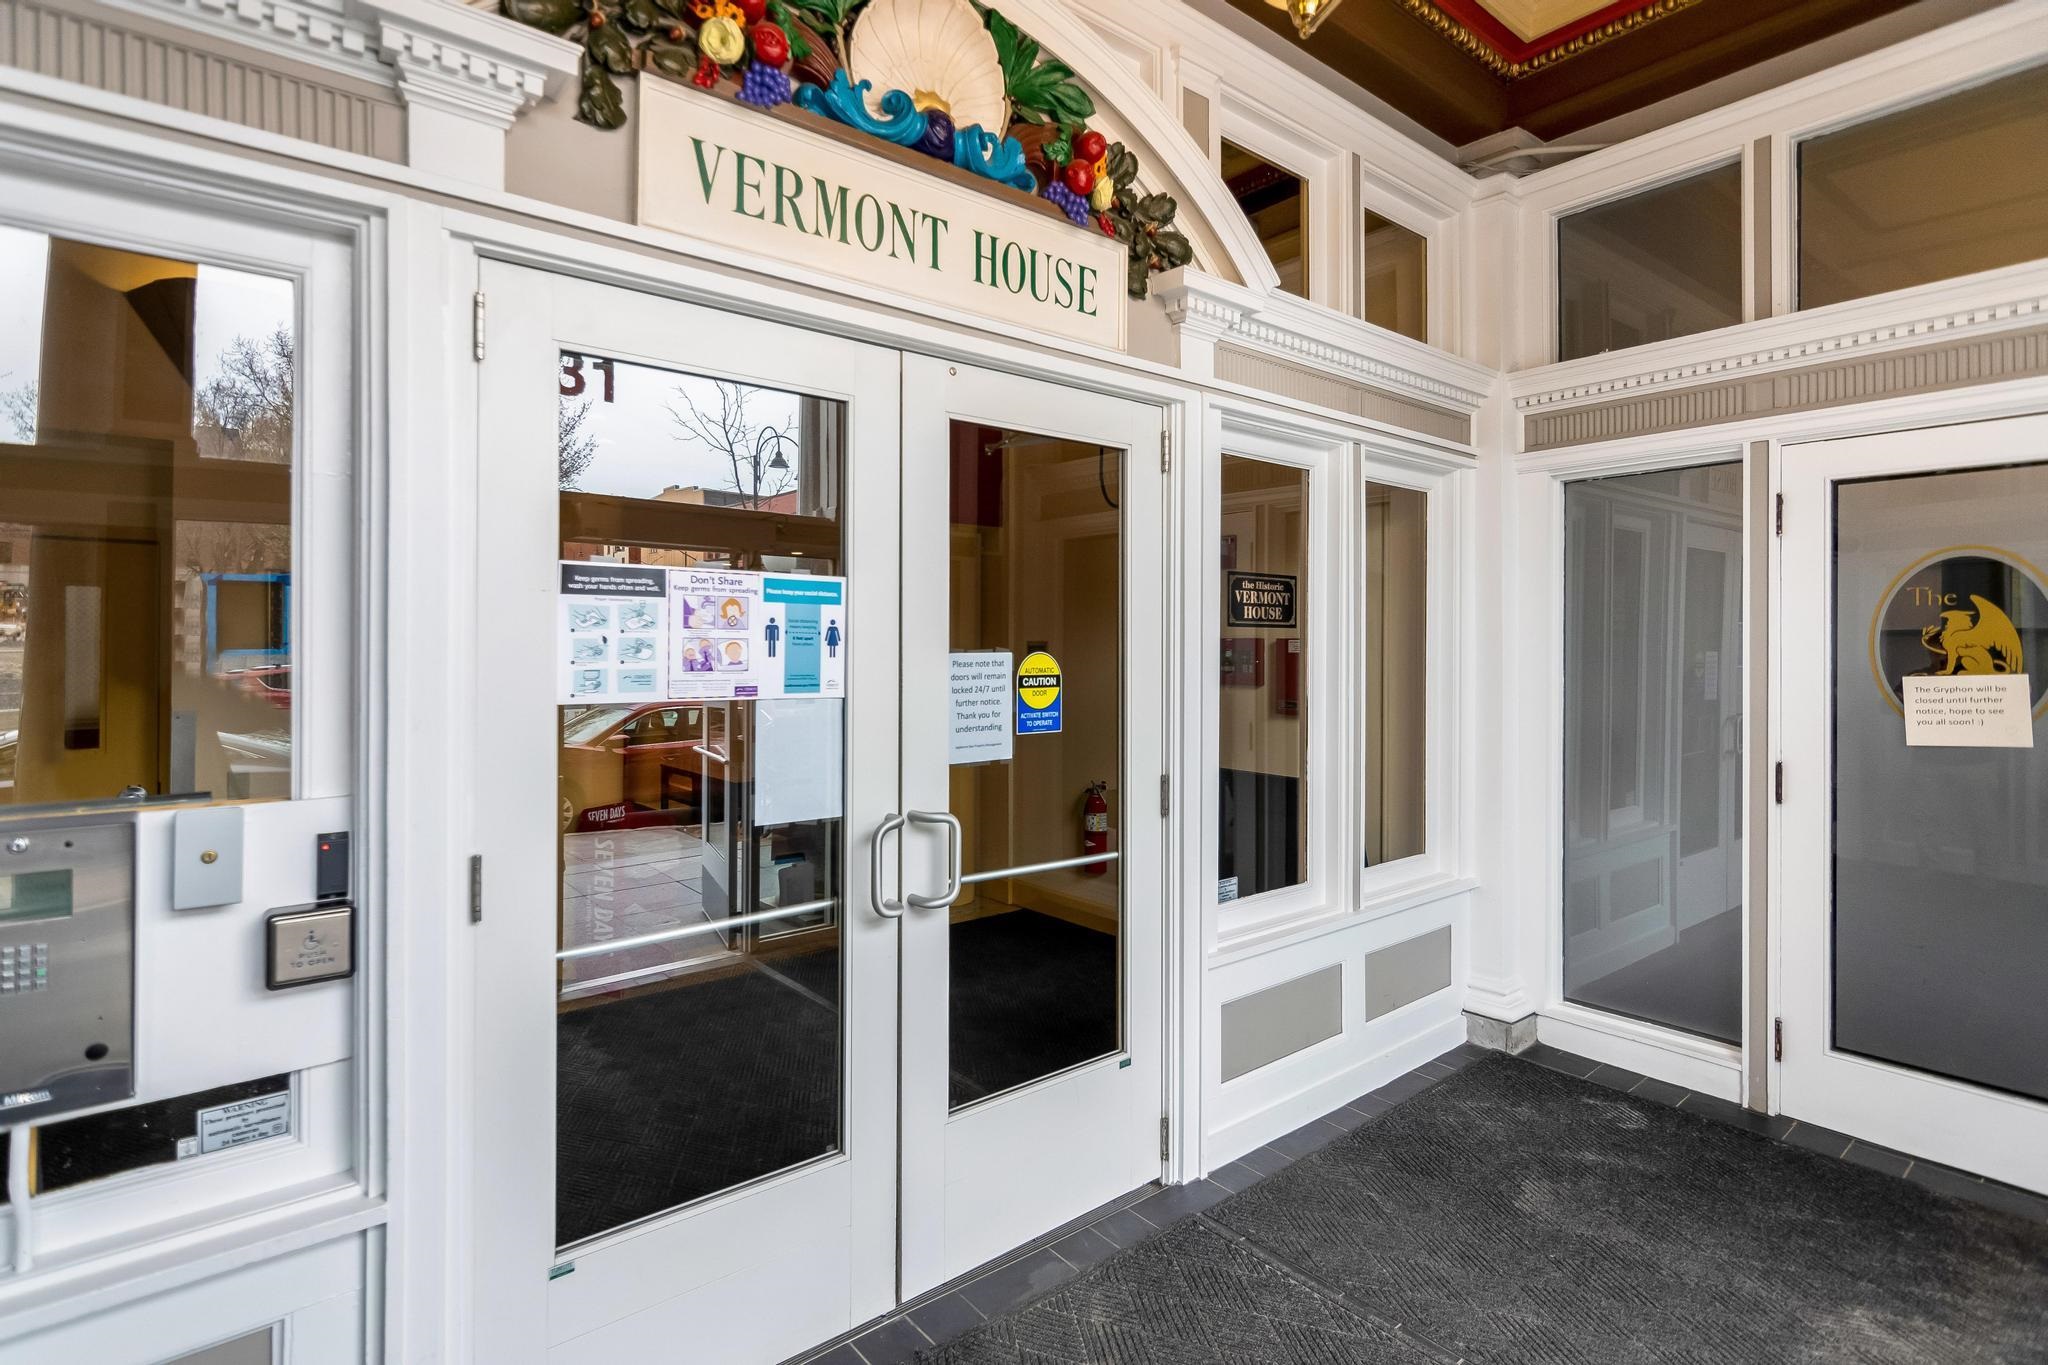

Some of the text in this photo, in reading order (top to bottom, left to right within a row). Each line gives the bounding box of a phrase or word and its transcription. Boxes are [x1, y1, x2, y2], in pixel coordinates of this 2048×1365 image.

[688, 136, 1097, 316] VERMONT HOUSE
[574, 575, 590, 583] Keep
[690, 575, 743, 586] Don't Share
[1242, 580, 1284, 591] the Historic
[729, 587, 758, 595] spreading
[1235, 590, 1291, 606] VERMONT
[1905, 586, 1957, 606] The
[1244, 605, 1283, 620] HOUSE
[952, 660, 974, 668] Please
[951, 673, 969, 681] doors
[1023, 677, 1056, 686] CAUTION
[951, 685, 1005, 694] locked 24/7 until
[1933, 686, 1973, 694] Gryphon
[1976, 685, 1992, 693] will
[1994, 685, 2007, 693] be
[955, 699, 978, 707] further
[1946, 696, 1967, 704] until
[1969, 696, 2003, 704] further
[957, 712, 976, 720] Thank
[1915, 708, 1947, 716] notice,
[1949, 707, 1973, 716] hope
[1935, 718, 1946, 726] all
[1948, 718, 1975, 726] soon!
[955, 724, 1003, 733] understanding
[587, 805, 626, 821] SEVEN DAYS
[593, 906, 615, 941] DAY
